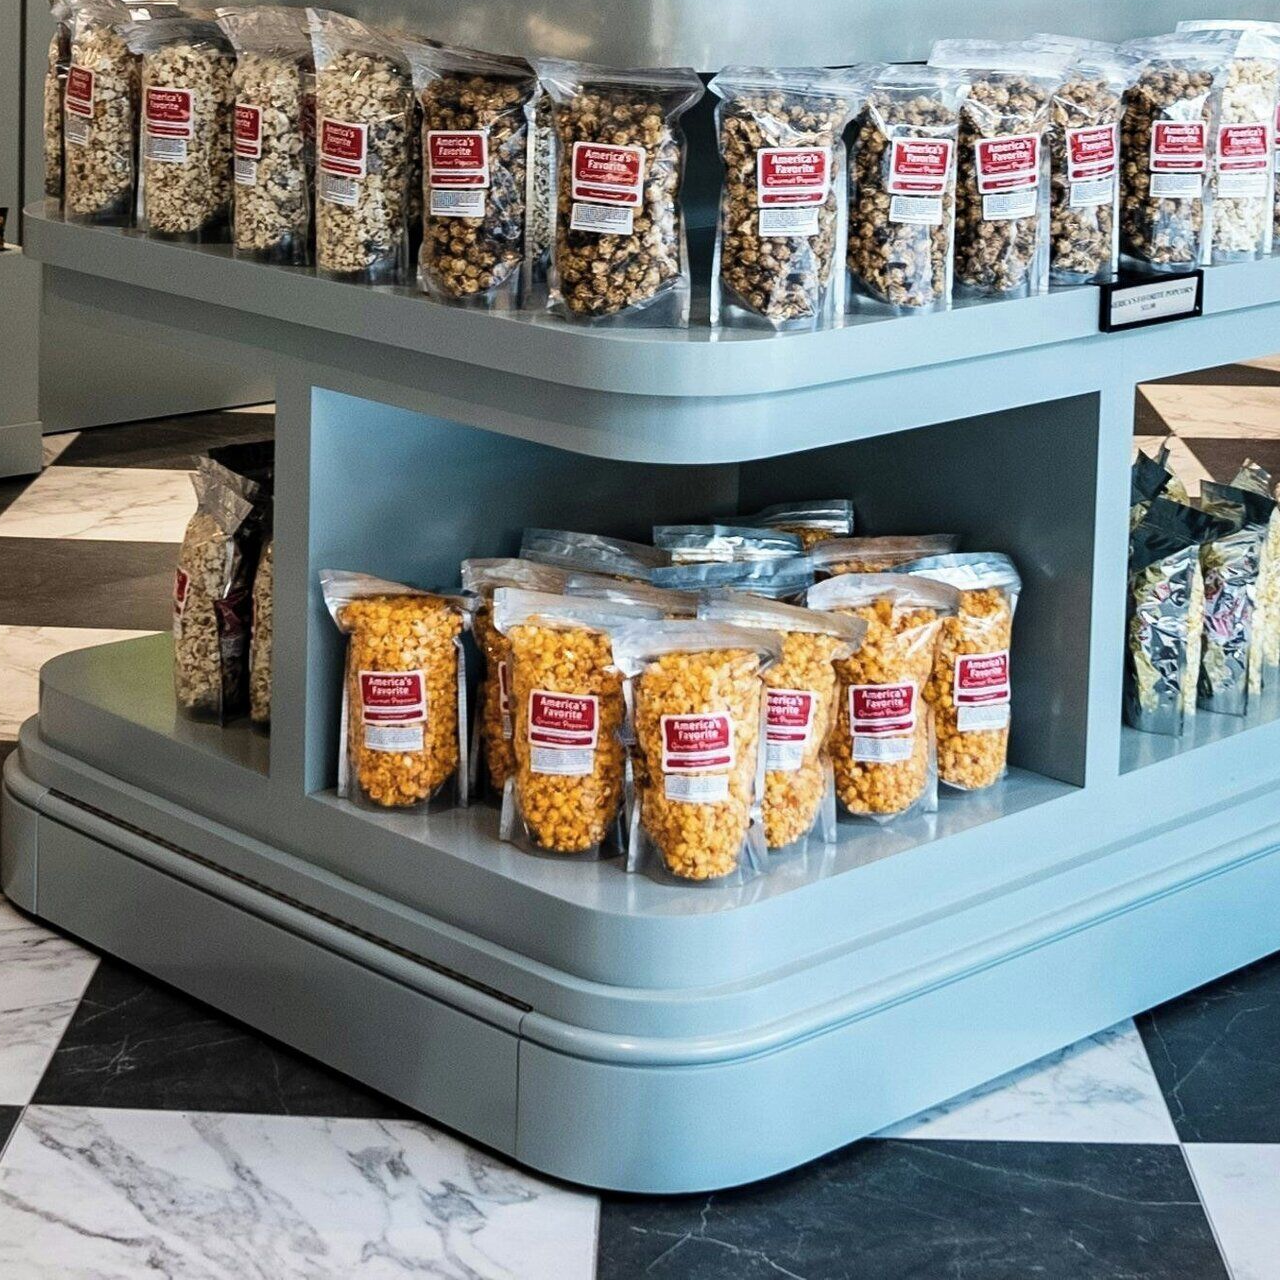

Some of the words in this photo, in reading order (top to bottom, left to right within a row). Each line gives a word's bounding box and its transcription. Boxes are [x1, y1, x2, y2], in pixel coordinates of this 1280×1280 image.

[1163, 125, 1199, 135] America's
[1228, 128, 1263, 138] America's
[436, 137, 474, 147] America's
[1167, 135, 1198, 143] Favorite
[439, 146, 472, 155] Favorite
[904, 144, 943, 154] America's
[988, 139, 1032, 153] America's
[585, 149, 632, 163] America's
[771, 154, 818, 165] America's
[906, 154, 940, 163] Favorite
[992, 150, 1030, 162] Favorite
[588, 161, 628, 172] Favorite
[775, 164, 814, 174] Favorite
[967, 657, 1004, 669] America's
[971, 667, 1003, 678] Favorite
[369, 676, 412, 686] America's
[372, 686, 409, 695] Favorite
[862, 688, 907, 699] America's
[540, 696, 587, 711] America's
[866, 697, 904, 707] Favorite
[543, 708, 582, 719] Favorite
[674, 719, 721, 731] America's
[679, 729, 719, 740] Favorite
